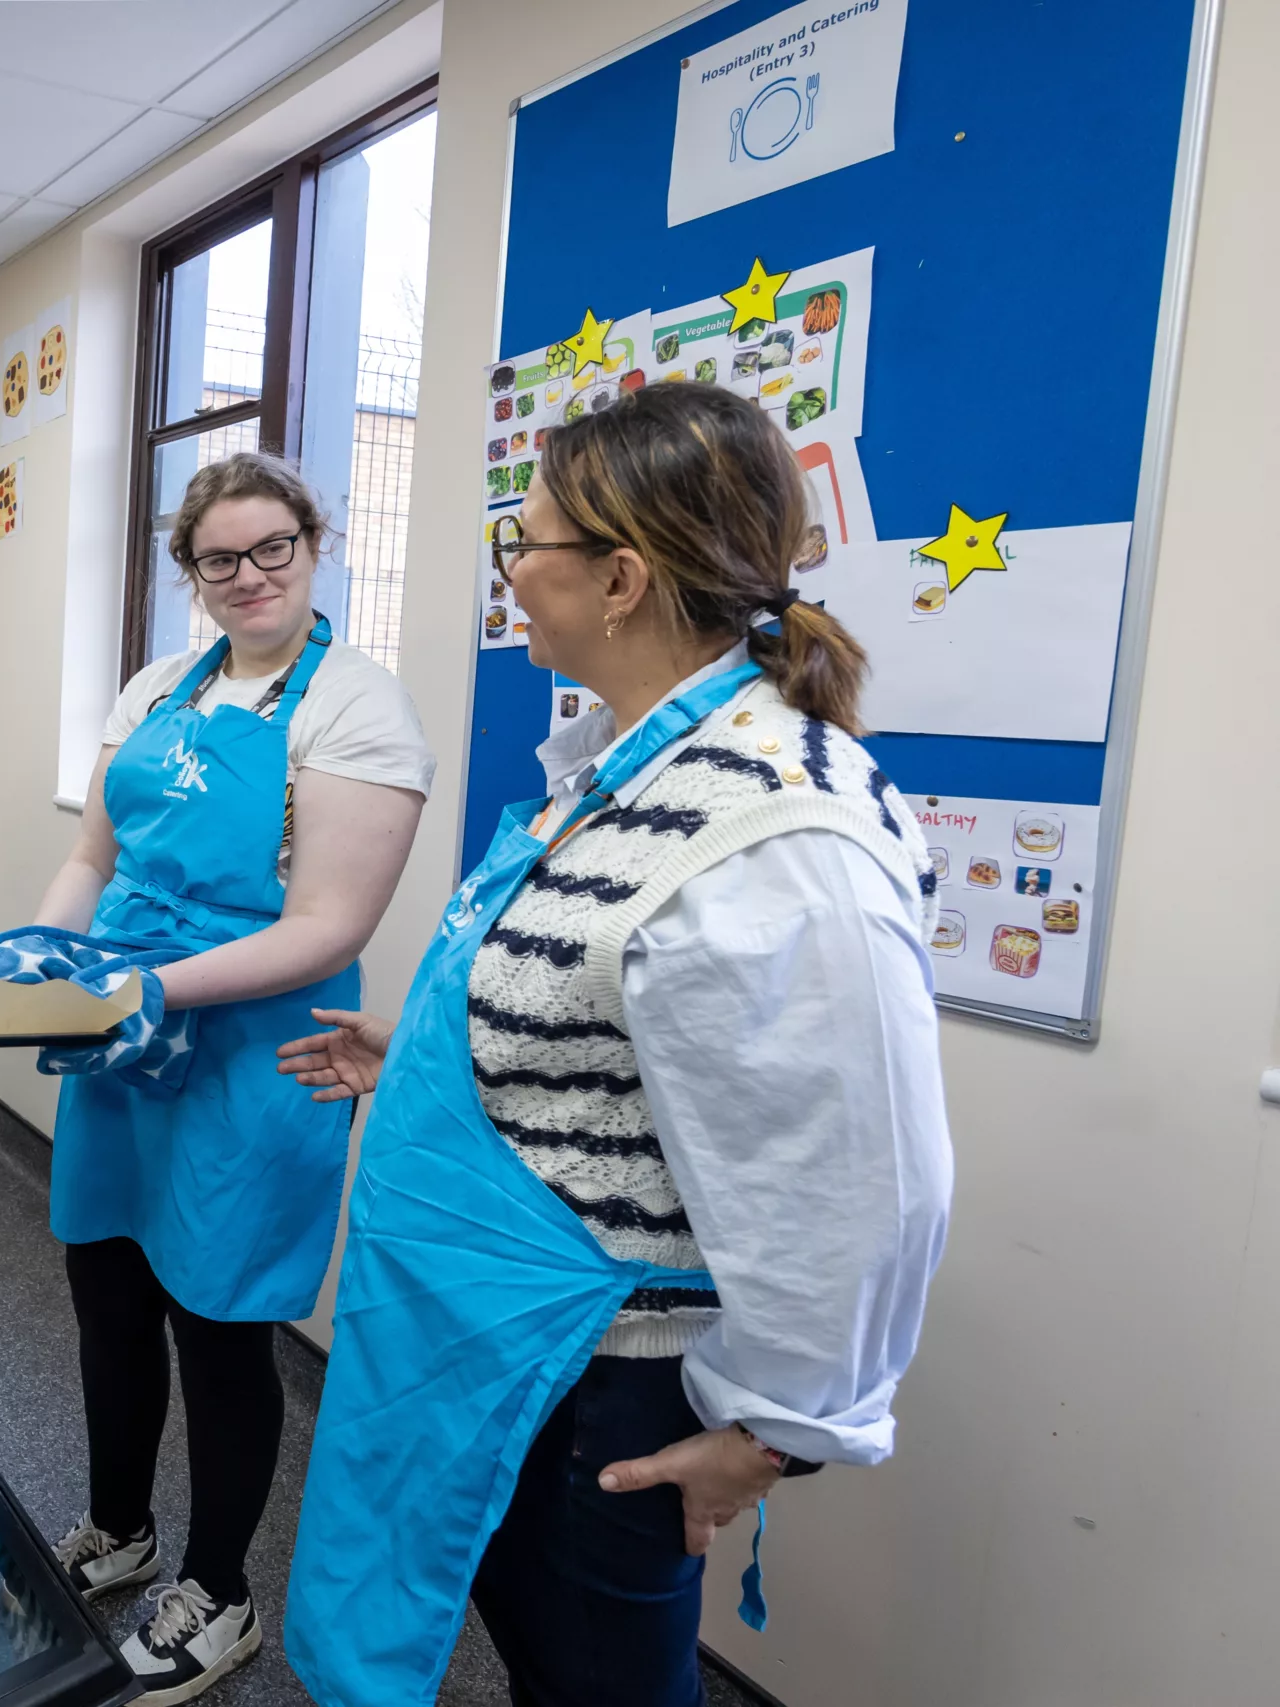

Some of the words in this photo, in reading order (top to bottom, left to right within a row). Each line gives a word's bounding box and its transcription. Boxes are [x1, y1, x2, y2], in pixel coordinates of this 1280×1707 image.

[700, 41, 775, 84] Hospitality
[778, 25, 806, 49] and
[810, 0, 880, 34] Catering
[748, 53, 795, 82] (Entry
[799, 41, 816, 58] 3)
[521, 371, 545, 383] Fruits
[915, 811, 977, 835] EALTHY
